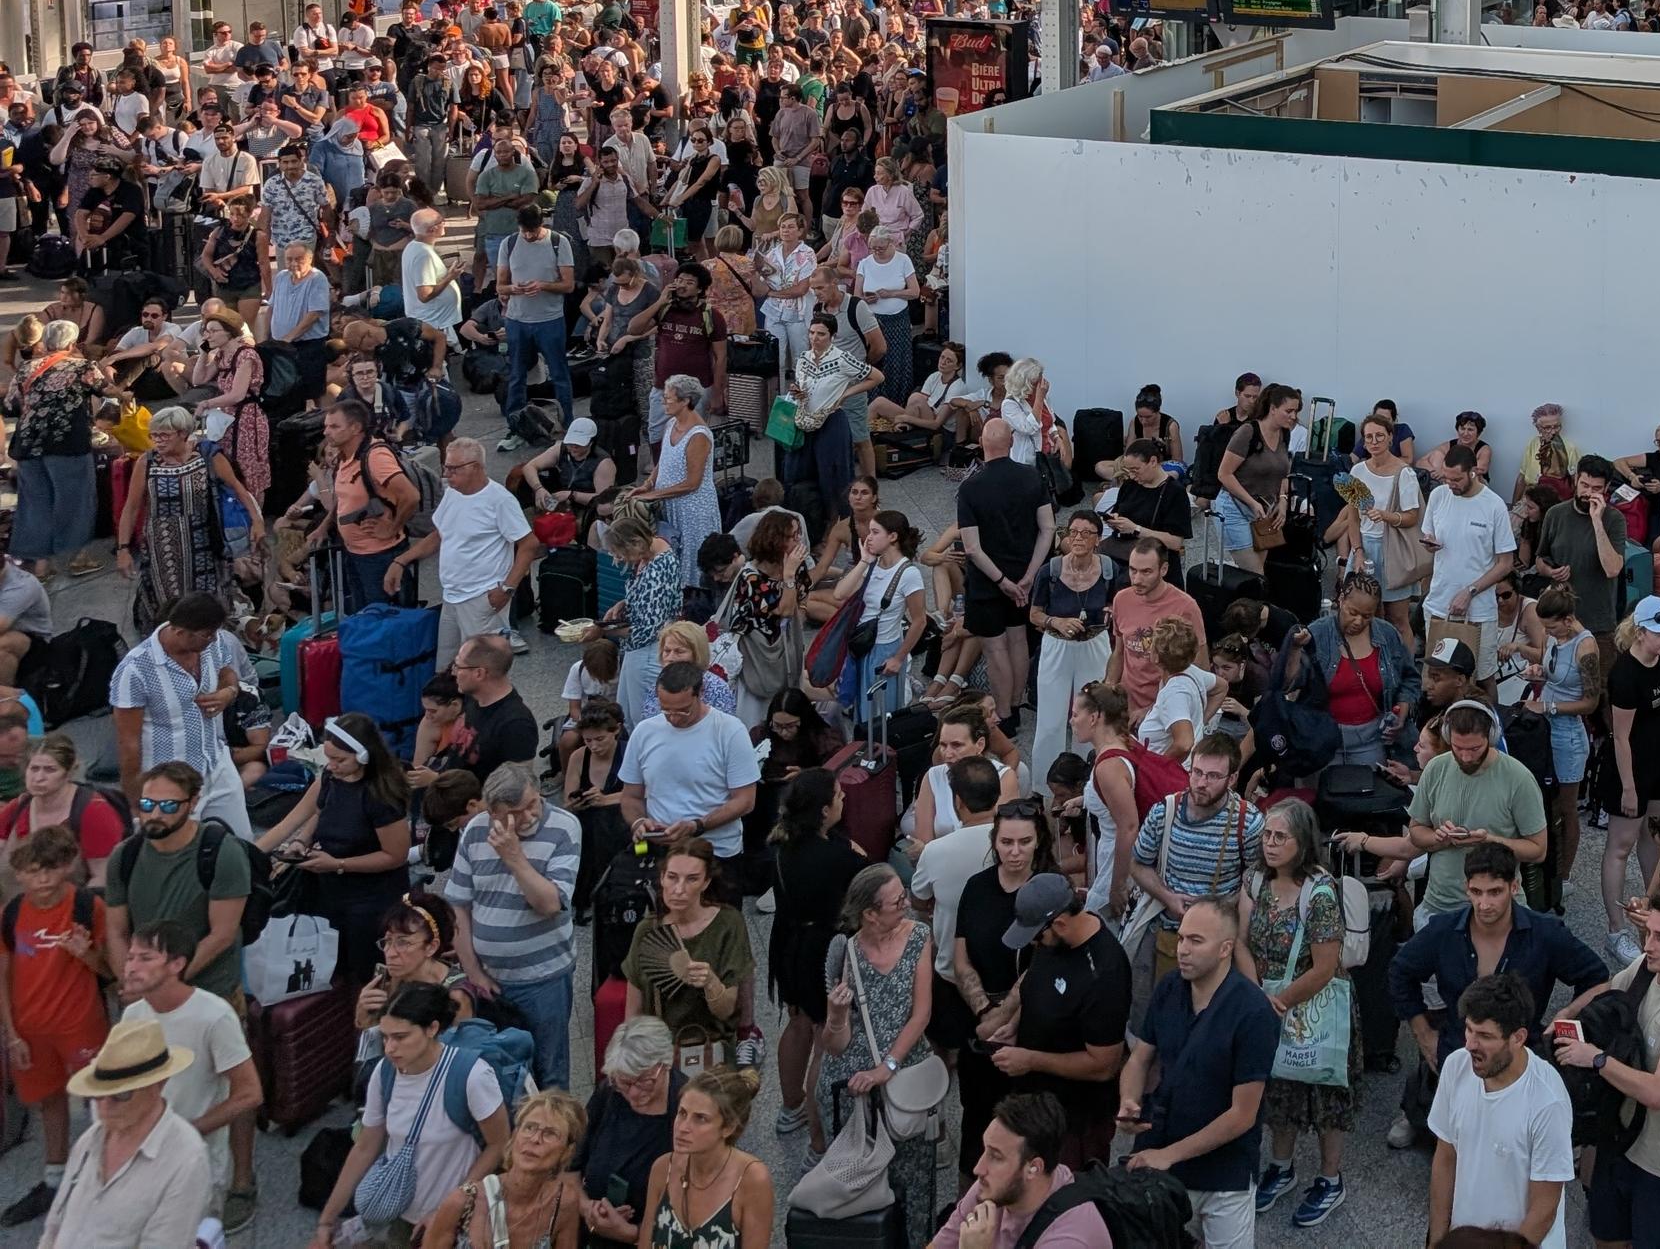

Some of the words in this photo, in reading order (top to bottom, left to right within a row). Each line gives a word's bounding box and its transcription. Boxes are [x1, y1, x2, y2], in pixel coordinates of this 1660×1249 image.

[950, 33, 990, 49] Bud
[971, 62, 1000, 76] BIÈRE
[971, 77, 1002, 90] ULTRA
[1285, 1049, 1317, 1059] MARSU
[1282, 1057, 1318, 1068] JUNGLE
